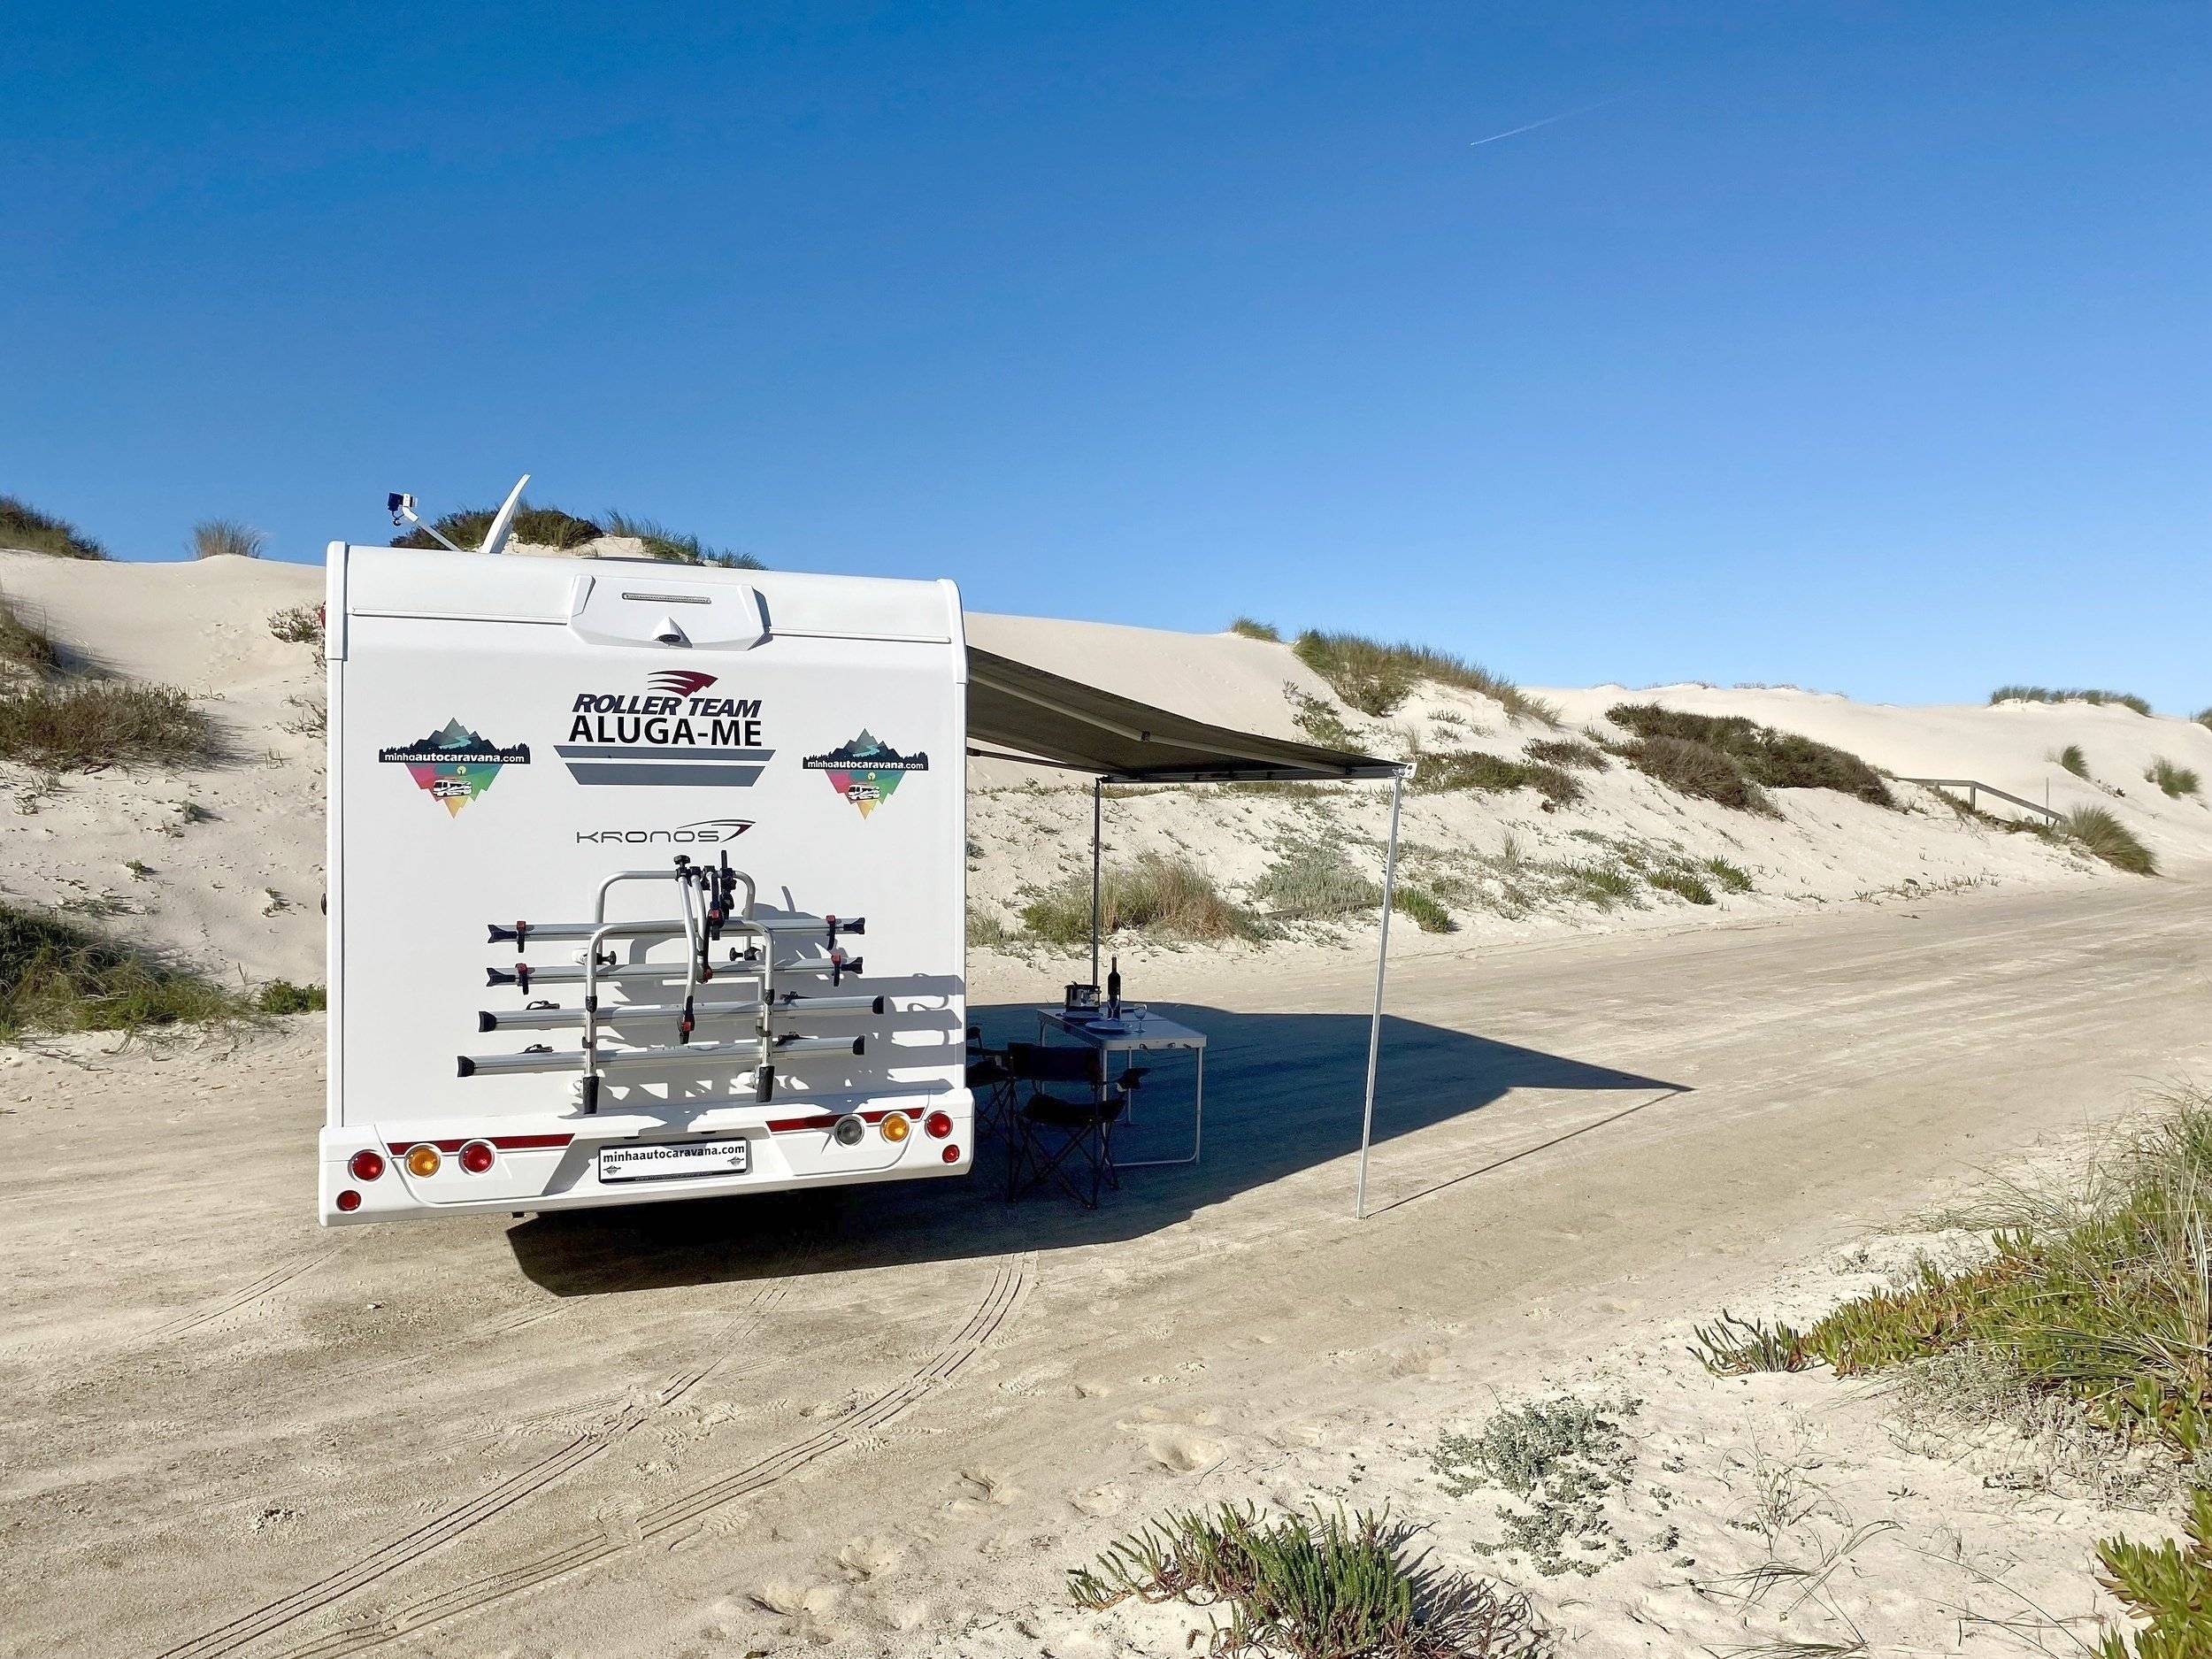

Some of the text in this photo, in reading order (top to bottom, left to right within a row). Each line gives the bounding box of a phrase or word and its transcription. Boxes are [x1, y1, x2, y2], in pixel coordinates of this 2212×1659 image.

[572, 694, 763, 718] ROLLER TEAM
[568, 715, 762, 747] ALUGA-ME
[384, 752, 525, 763] minhaautocaravana.com
[807, 759, 924, 770] minhaautocaravana.com
[576, 830, 719, 843] KRONOS
[603, 1145, 745, 1163] minhaautocaravana.com
